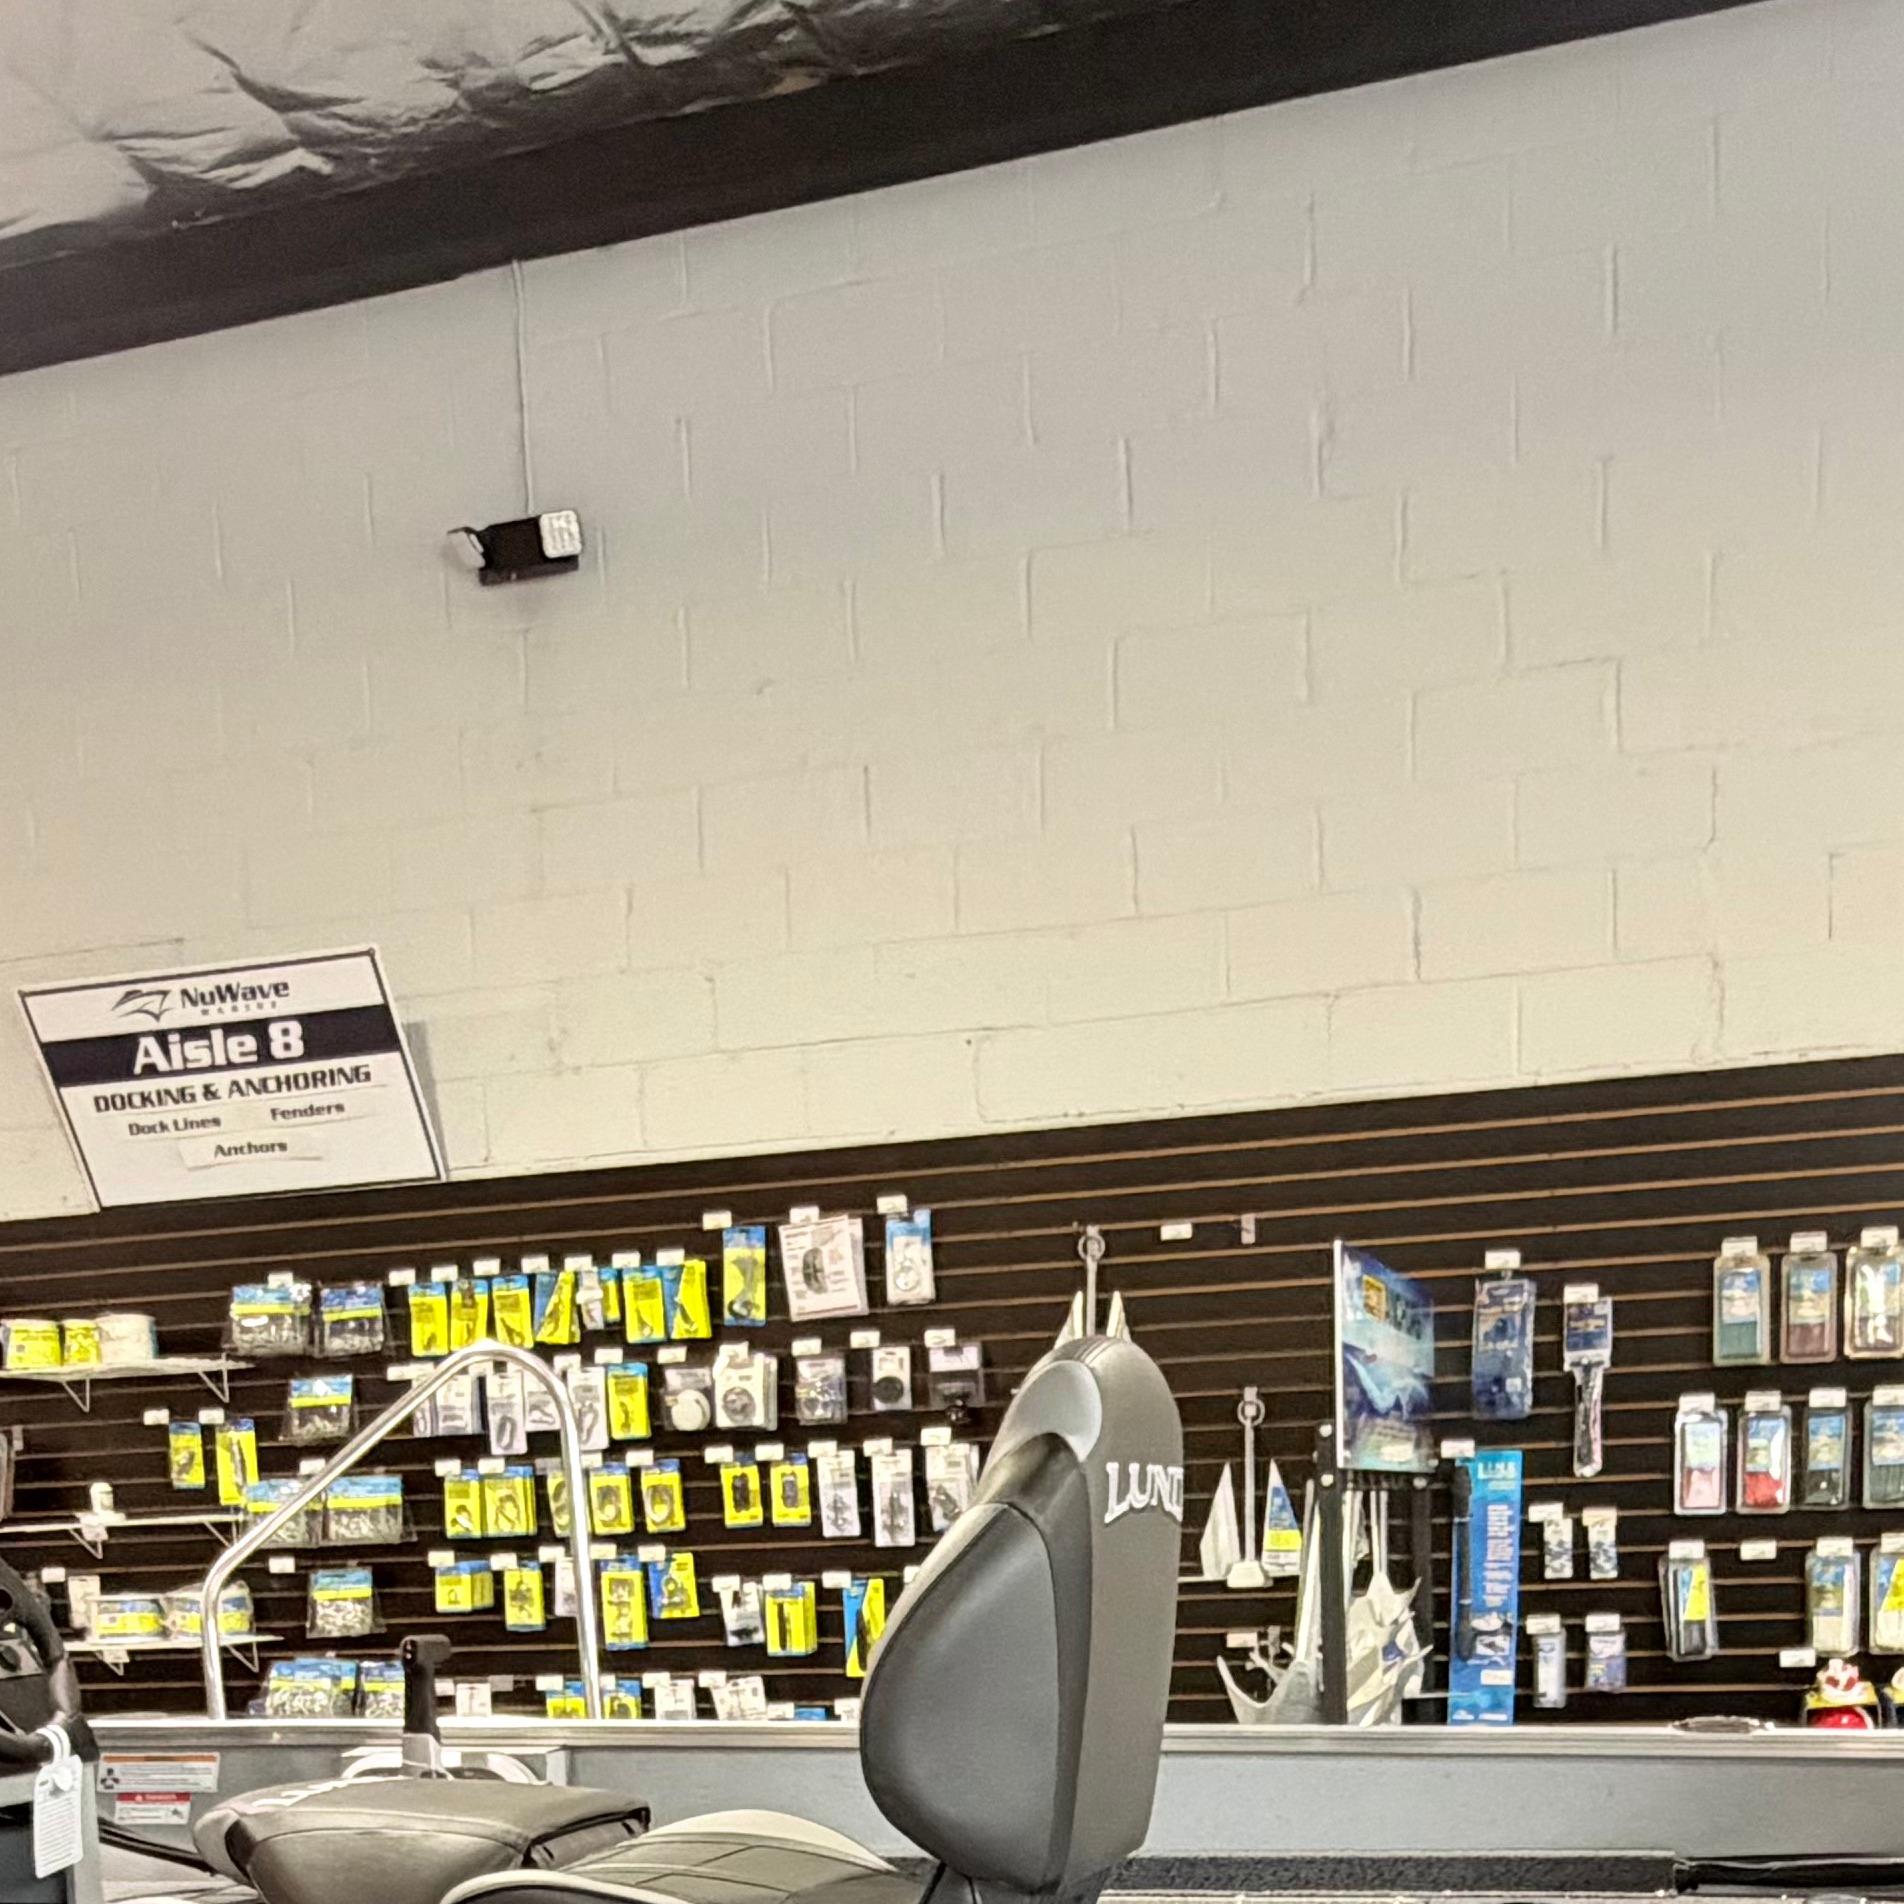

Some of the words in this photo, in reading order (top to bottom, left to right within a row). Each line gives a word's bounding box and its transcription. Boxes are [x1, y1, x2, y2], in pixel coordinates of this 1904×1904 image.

[179, 981, 290, 1009] NuWave
[133, 1028, 258, 1076] Aisle
[268, 1020, 305, 1060] 8
[93, 1085, 196, 1113] DOCKING
[202, 1083, 222, 1101] &
[228, 1064, 372, 1098] ANCHORING
[270, 1102, 345, 1121] Fenders
[128, 1119, 170, 1136] Dock
[173, 1116, 222, 1132] Lines
[214, 1140, 288, 1158] Anchors
